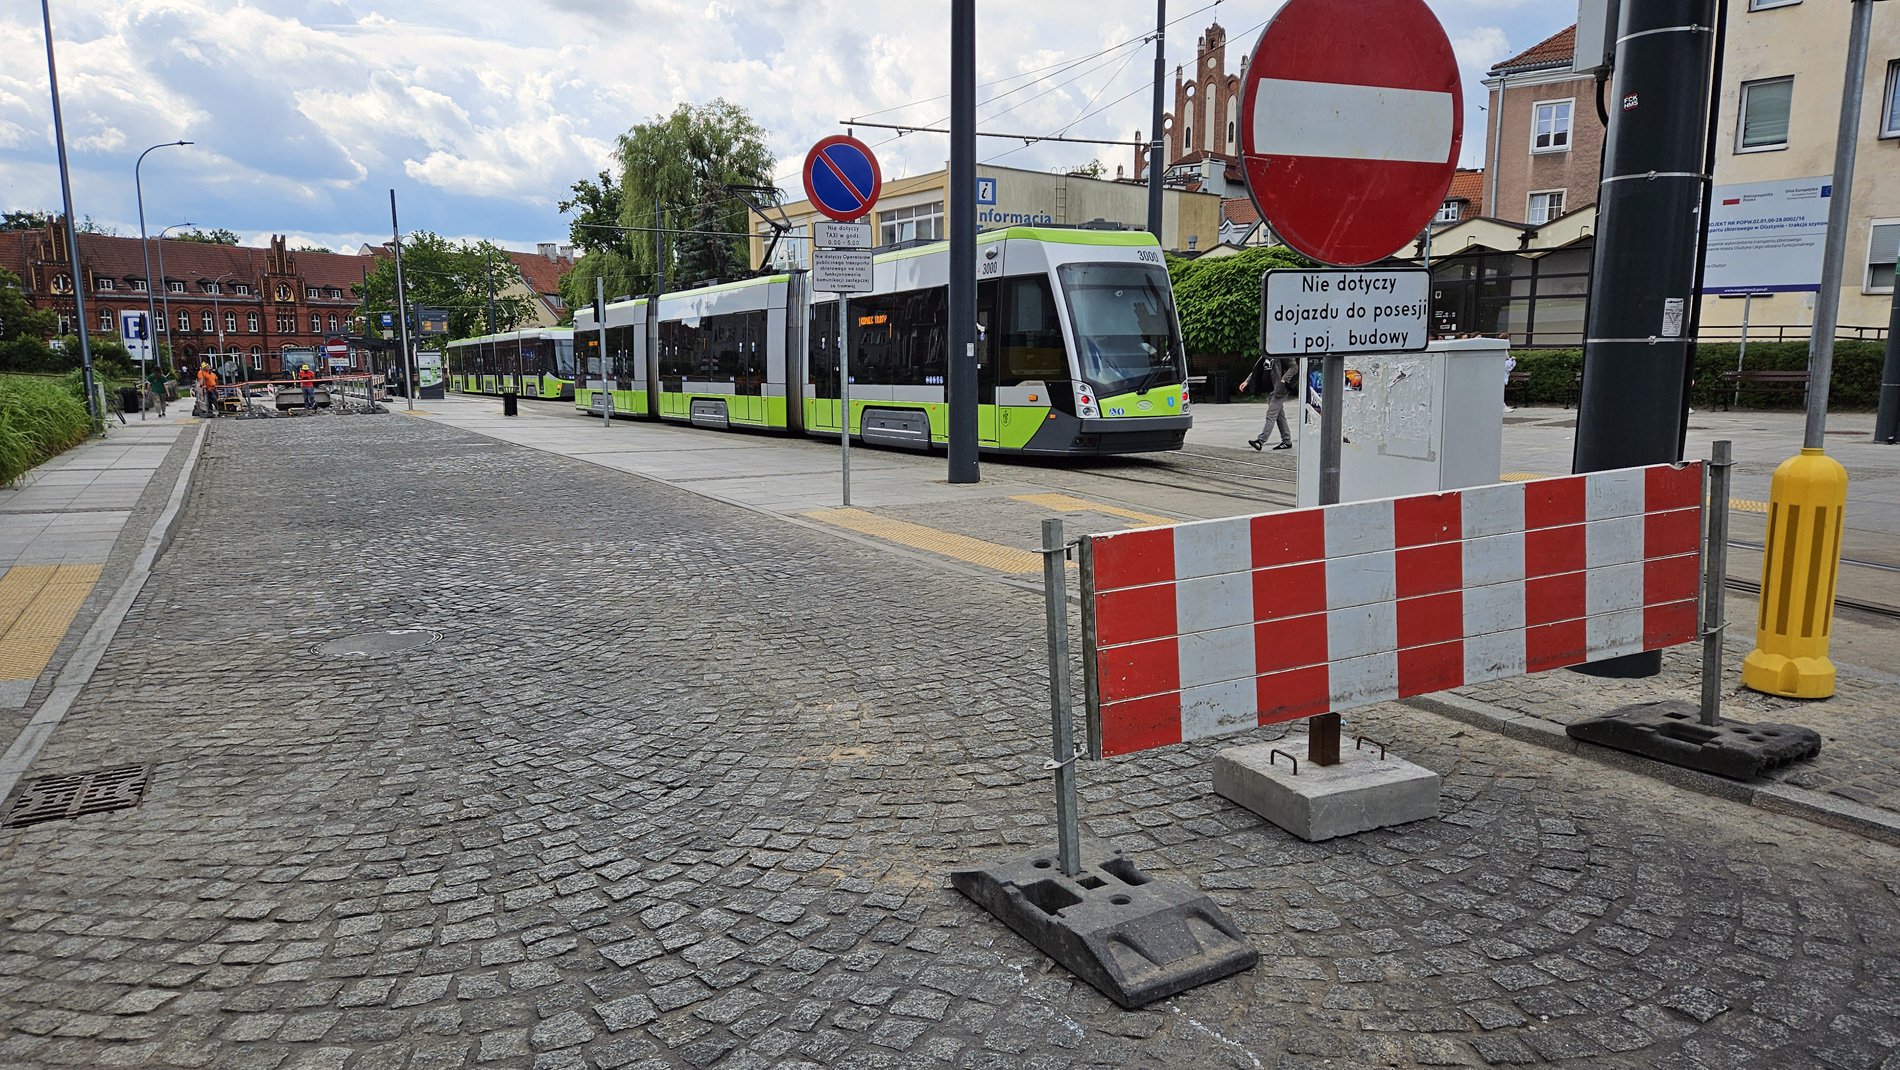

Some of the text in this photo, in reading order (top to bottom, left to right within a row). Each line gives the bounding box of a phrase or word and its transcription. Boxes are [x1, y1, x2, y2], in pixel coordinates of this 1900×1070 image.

[1624, 95, 1637, 104] FCK
[1137, 250, 1159, 262] 3000
[982, 261, 997, 275] 3000
[1302, 274, 1397, 295] Nie dotyczy
[1274, 299, 1427, 325] dojazdu do posesji
[1292, 328, 1408, 353] i poj. budowy
